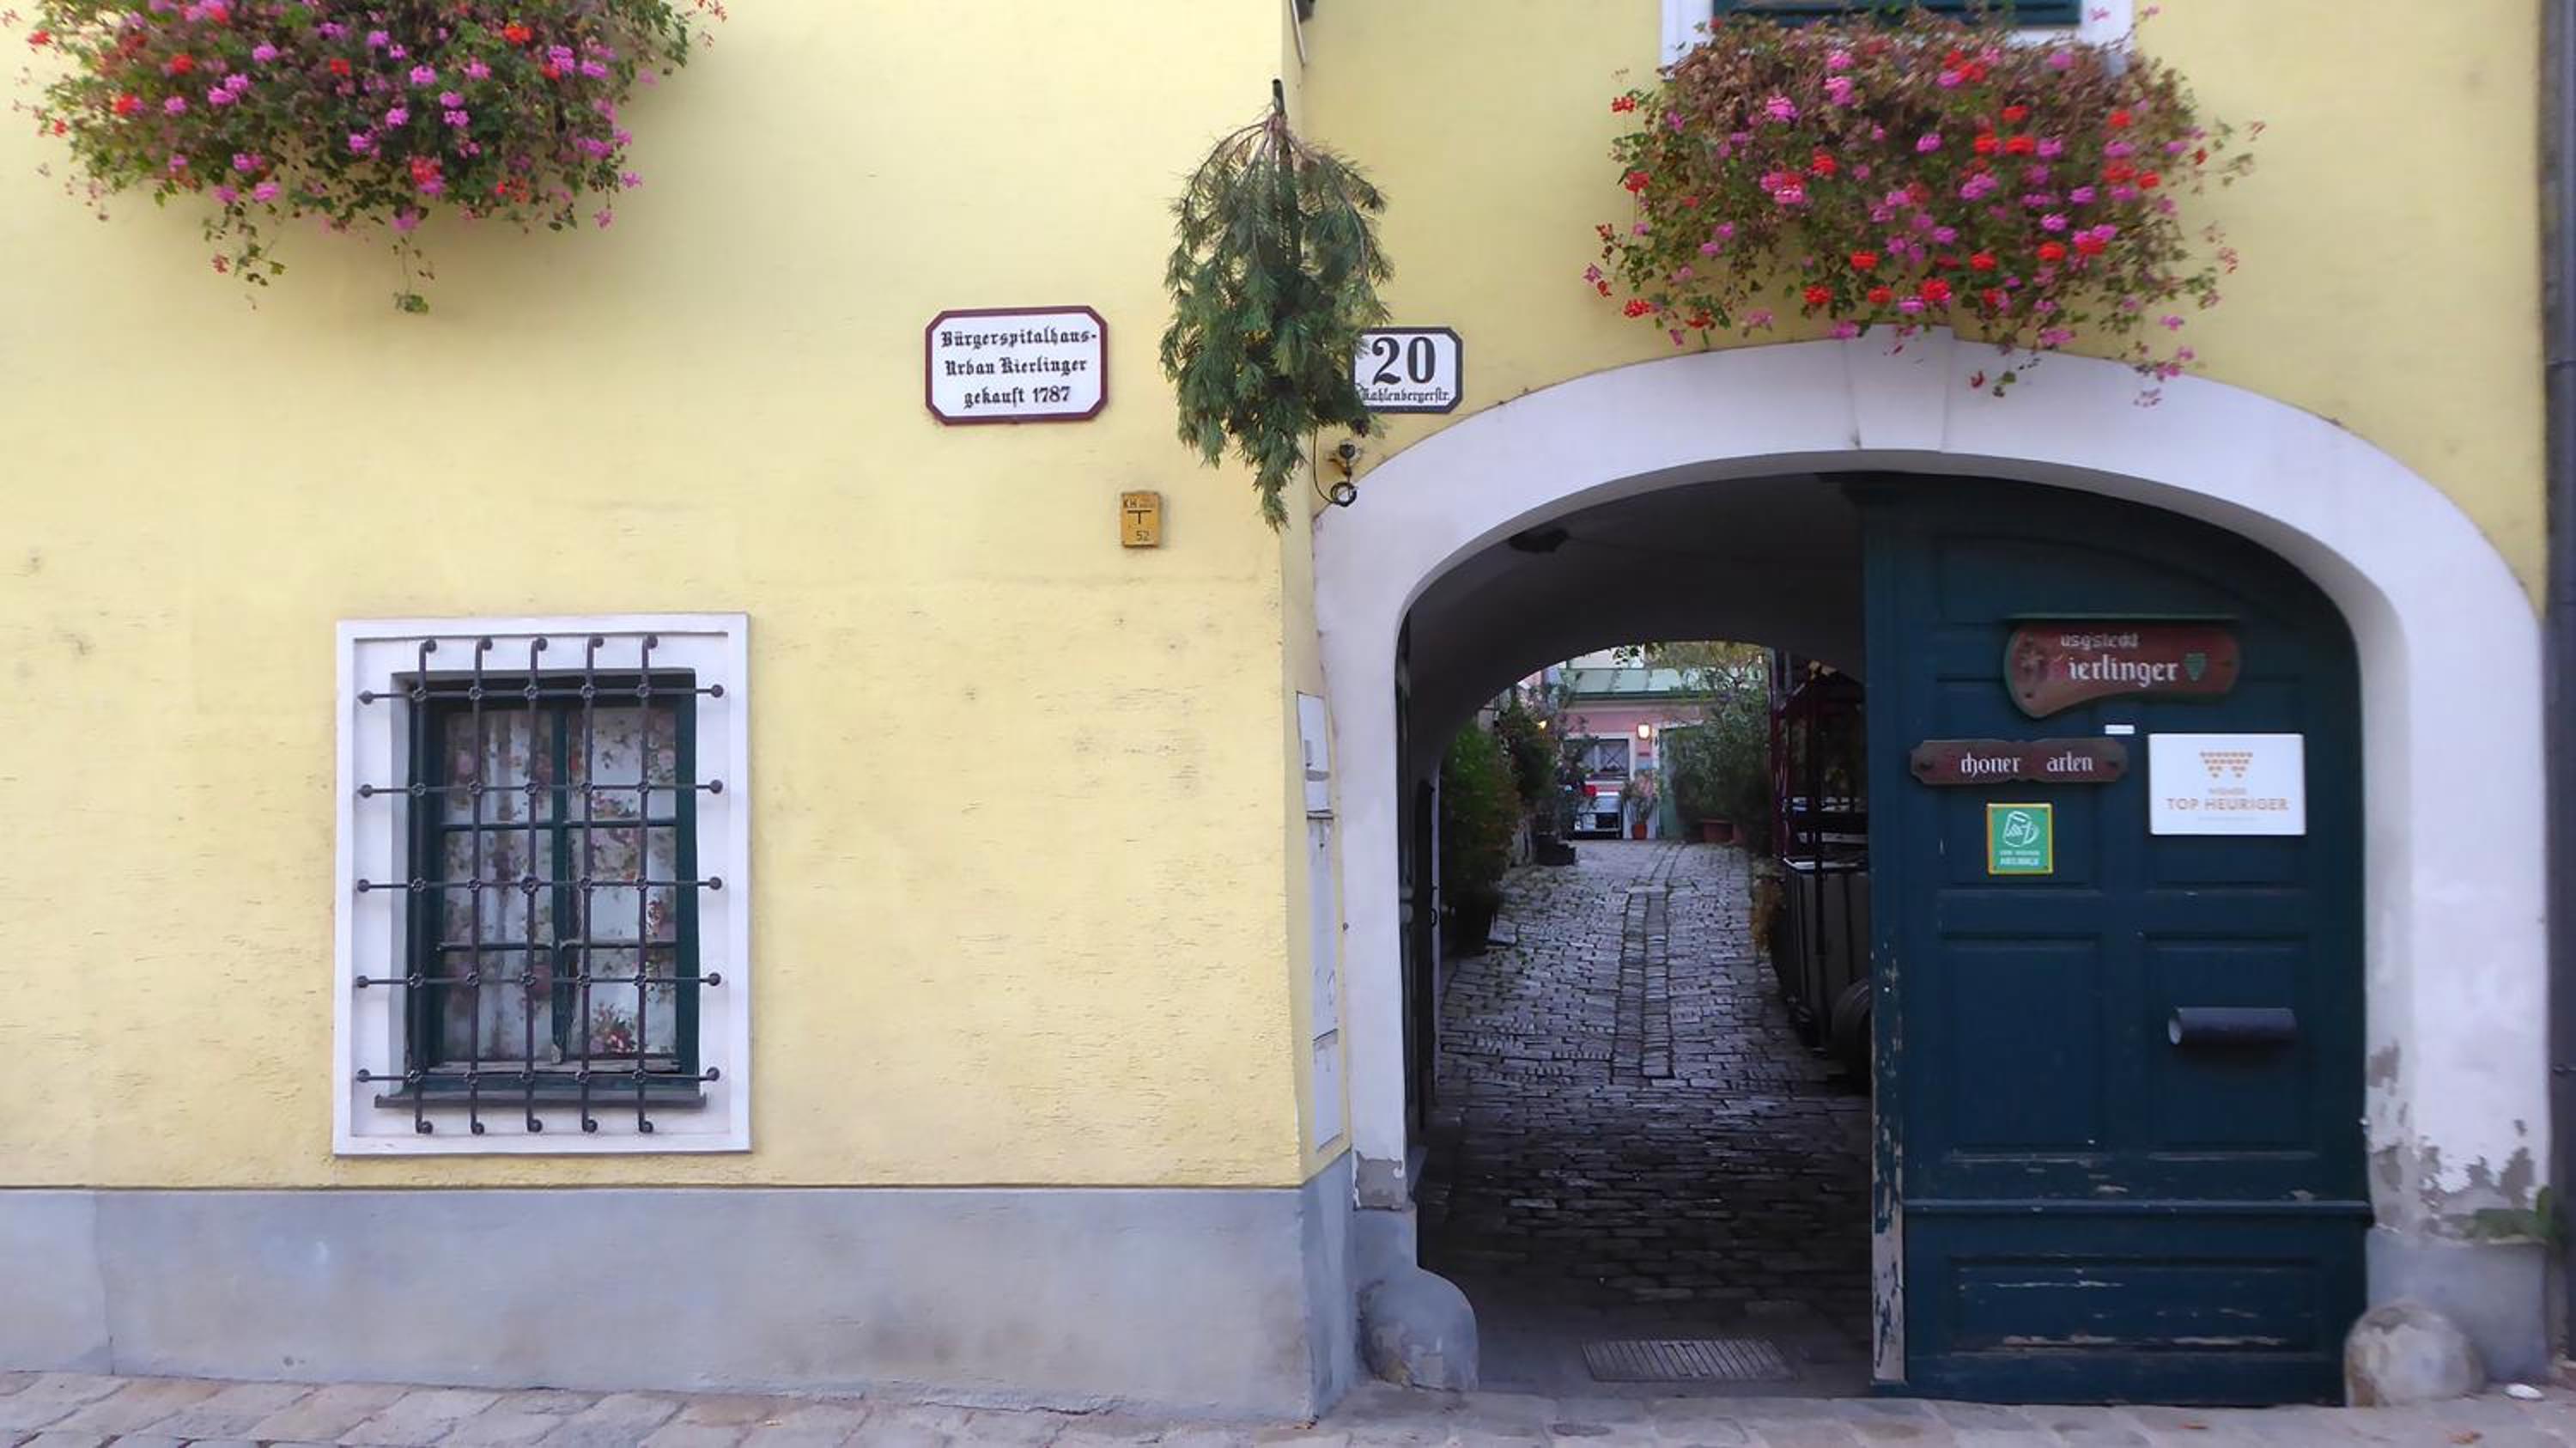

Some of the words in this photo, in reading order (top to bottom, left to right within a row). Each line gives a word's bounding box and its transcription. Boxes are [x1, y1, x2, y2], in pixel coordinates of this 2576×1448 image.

[940, 326, 1097, 350] Bürgerspitalhaus-
[999, 356, 1088, 377] Kierlinger
[1371, 336, 1437, 385] 20
[963, 386, 1025, 409] gekauft
[1032, 386, 1072, 404] 1787
[1135, 530, 1150, 542] 52
[2166, 798, 2198, 811] TOP
[2204, 798, 2289, 811] HEURIGER
